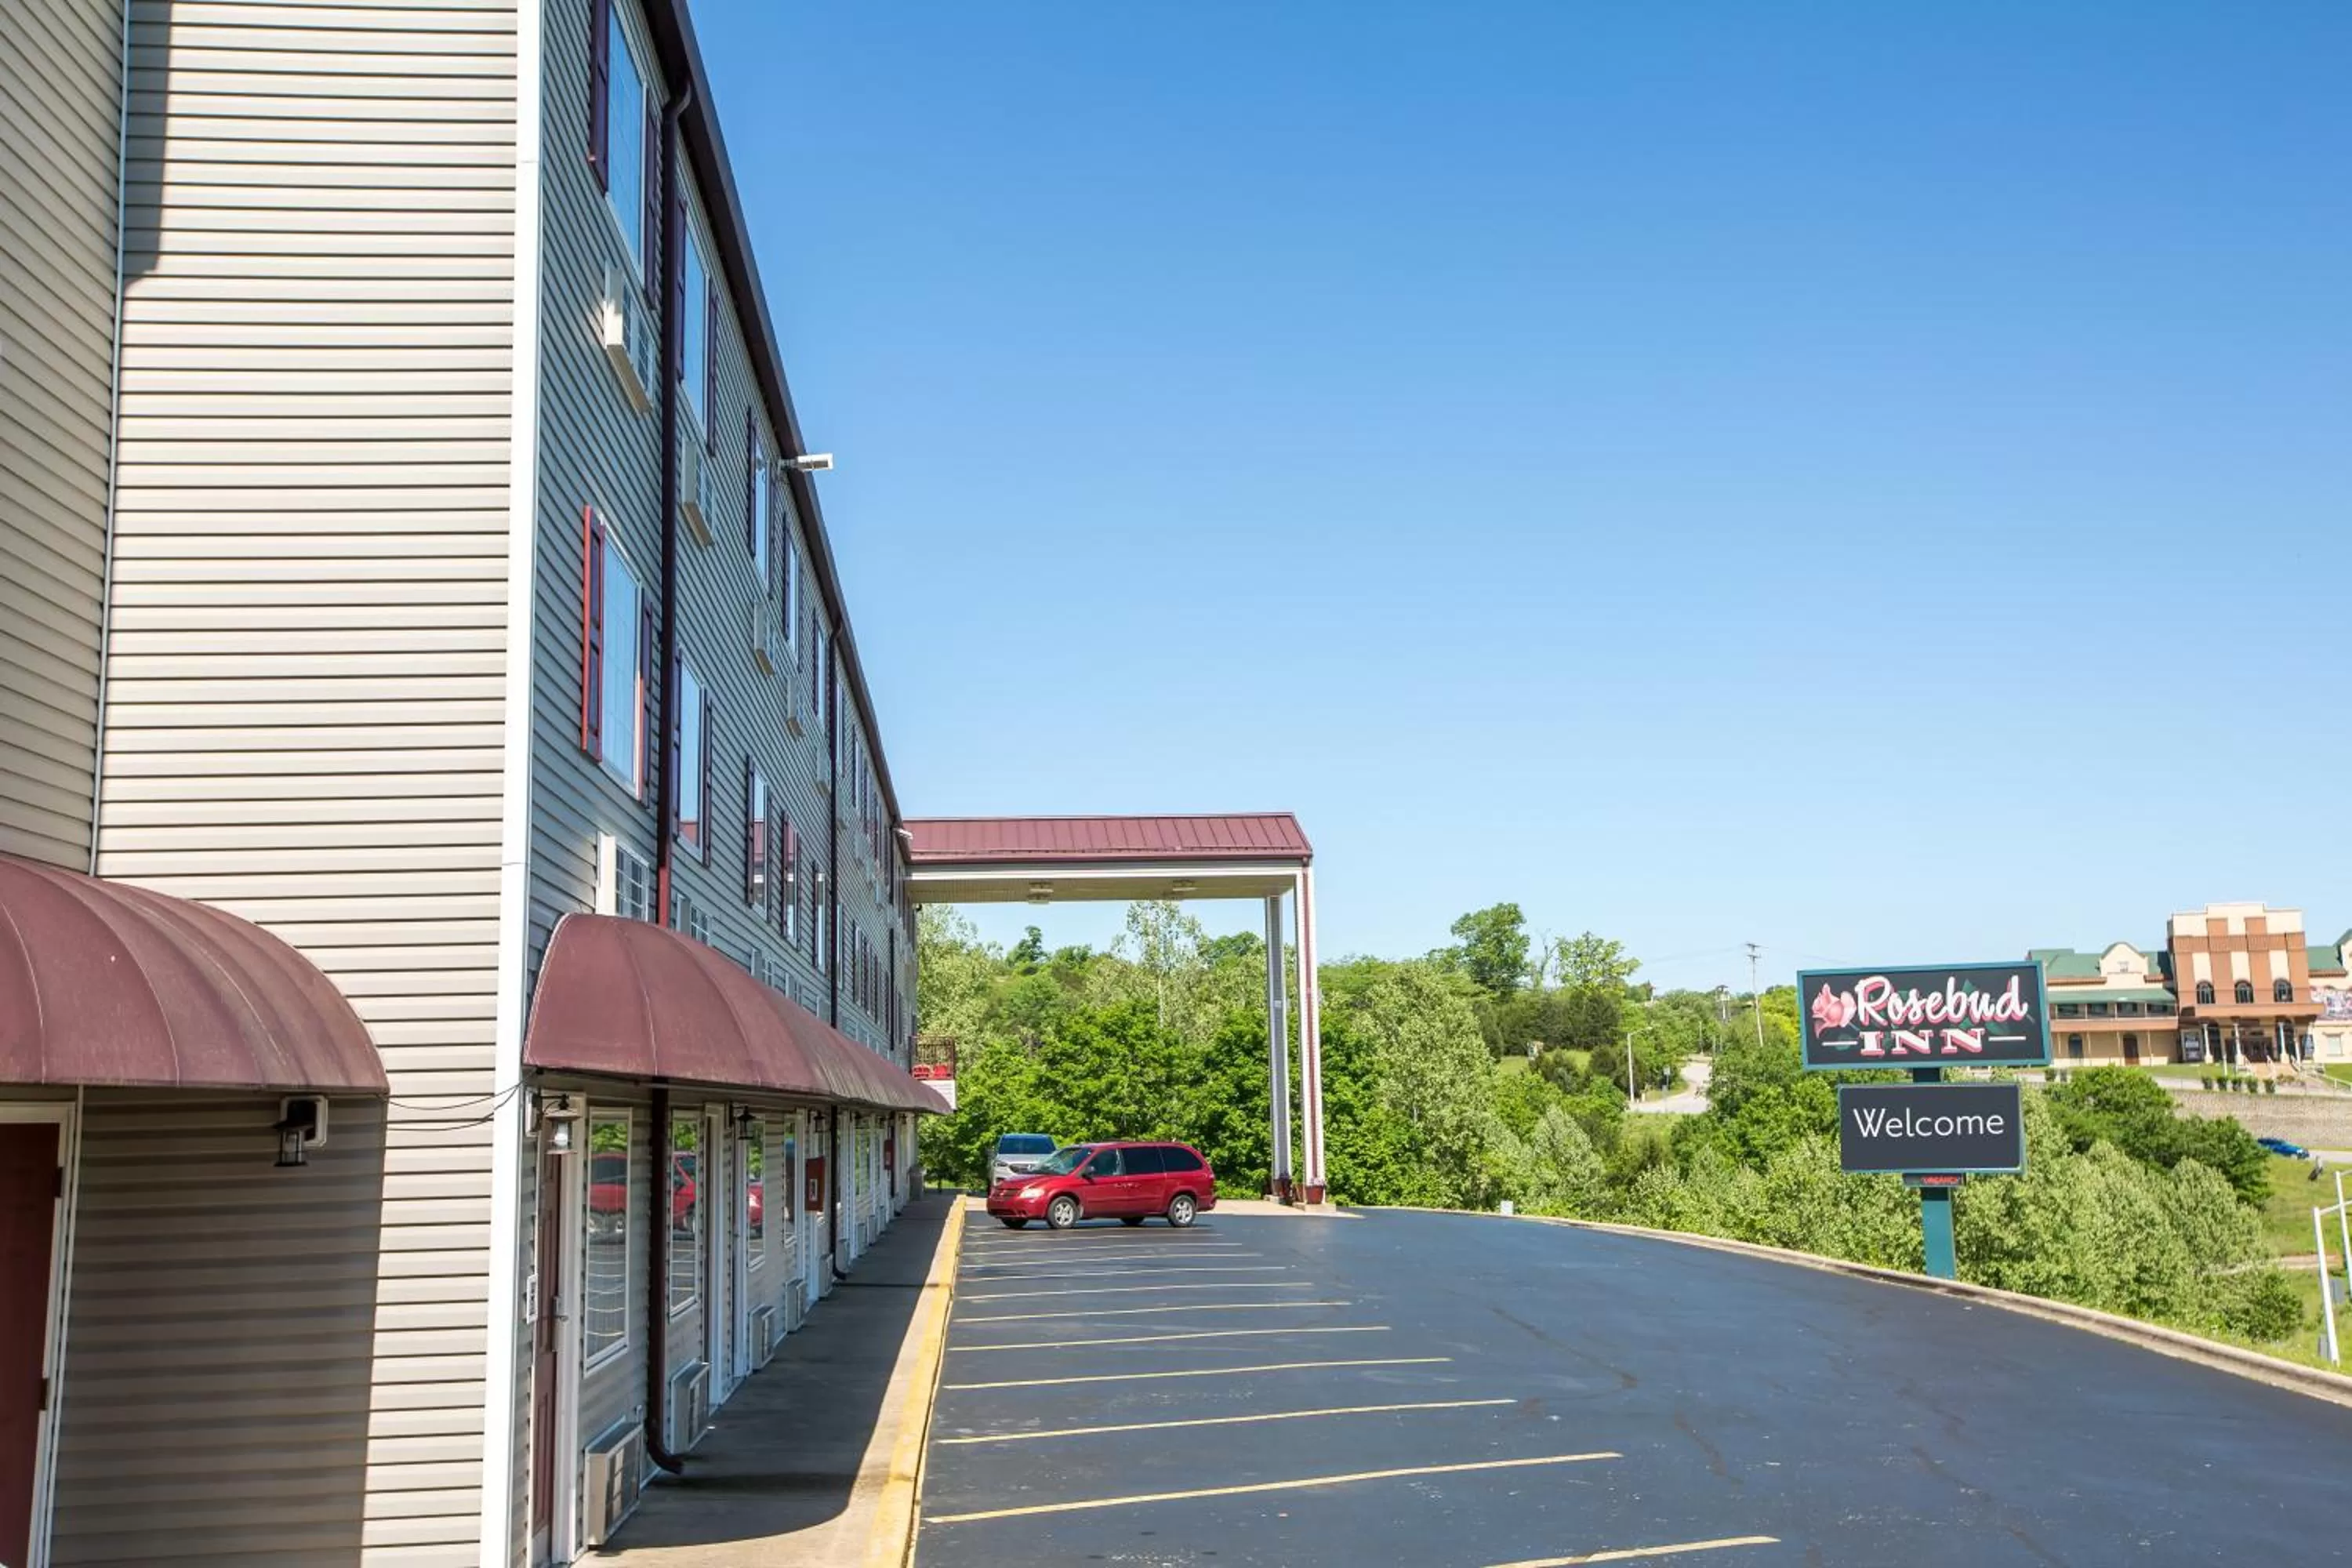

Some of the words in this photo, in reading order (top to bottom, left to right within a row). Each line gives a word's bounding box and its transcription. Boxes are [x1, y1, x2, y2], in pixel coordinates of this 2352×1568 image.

[1854, 975, 2028, 1025] Rosebud
[1859, 1028, 1985, 1056] INN
[1853, 1107, 2005, 1138] Welcome
